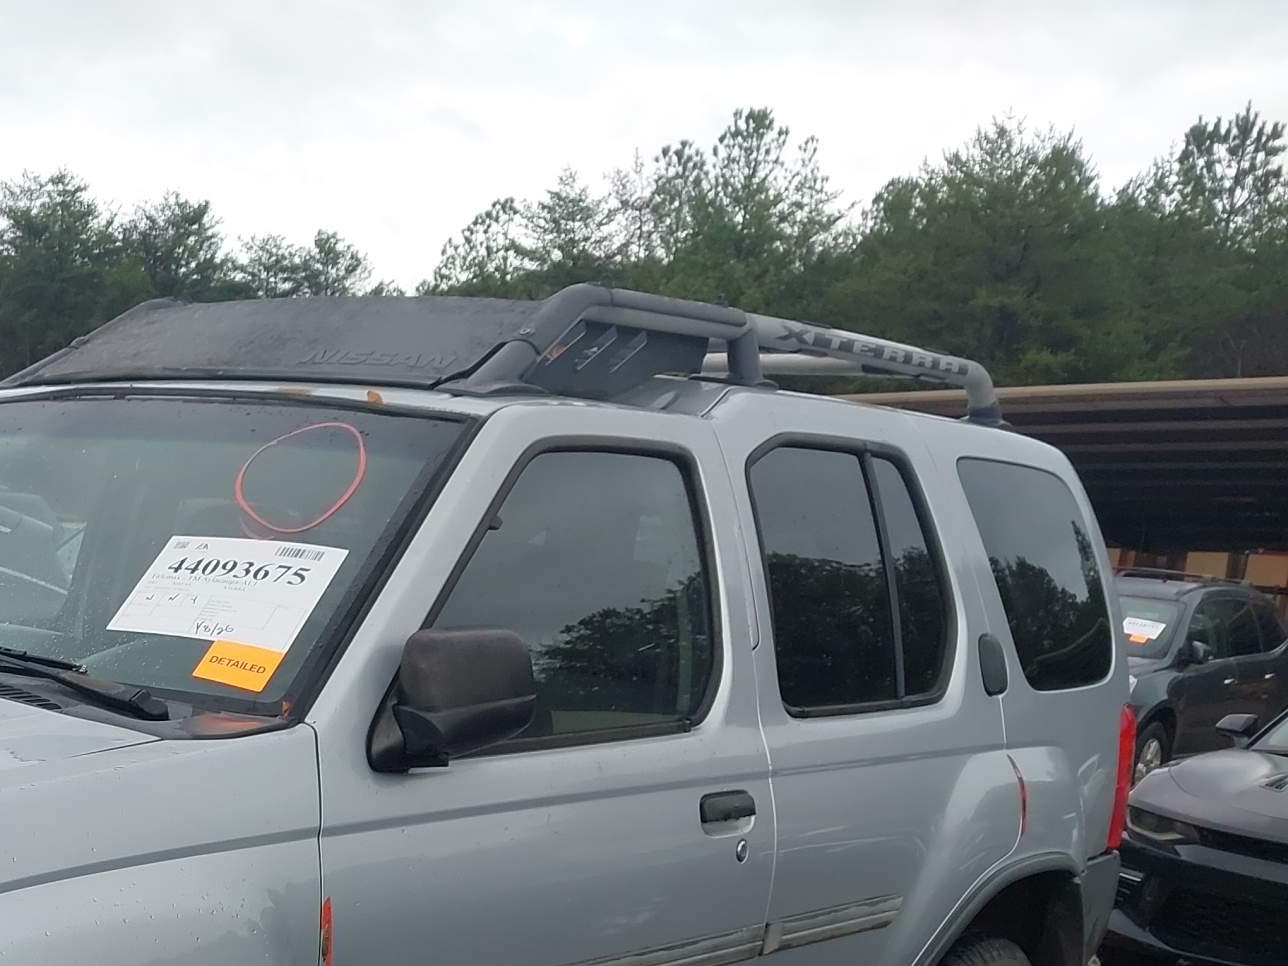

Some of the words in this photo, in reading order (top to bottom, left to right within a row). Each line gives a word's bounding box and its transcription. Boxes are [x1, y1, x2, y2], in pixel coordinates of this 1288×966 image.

[298, 348, 459, 371] NISSAN
[775, 325, 968, 375] XTERRA
[167, 557, 312, 586] 44093675
[208, 655, 267, 675] DETAILED
